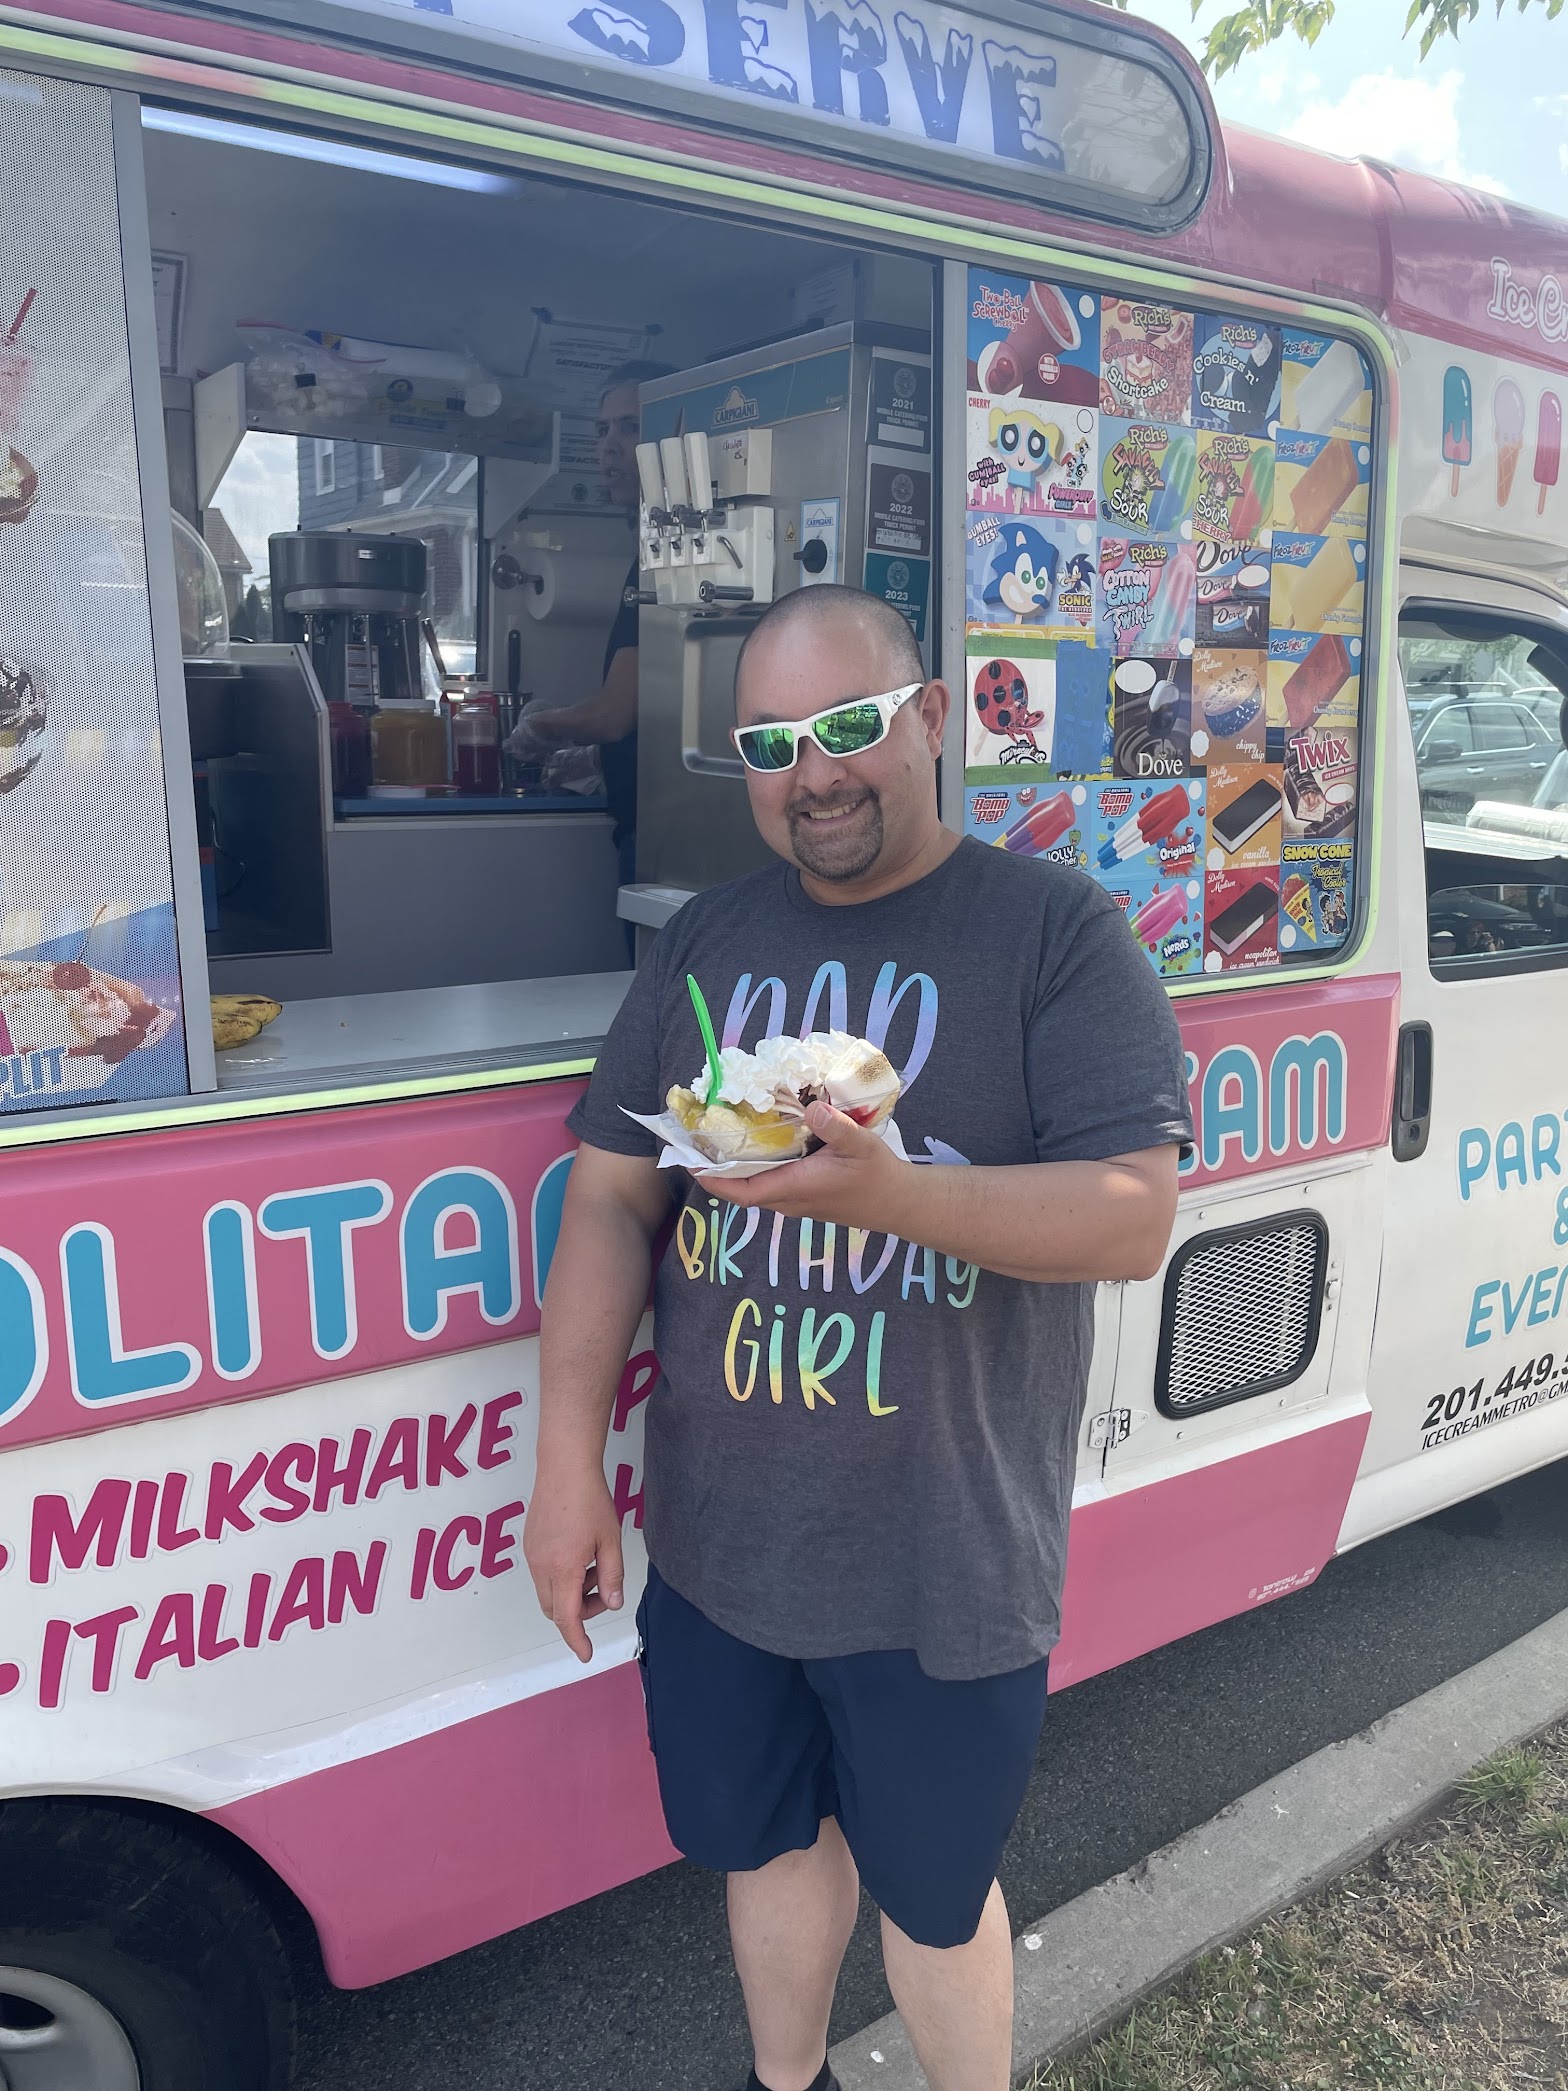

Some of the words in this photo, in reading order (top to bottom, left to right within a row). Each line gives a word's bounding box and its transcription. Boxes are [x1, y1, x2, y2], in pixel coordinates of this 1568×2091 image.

[1490, 260, 1533, 325] Ice
[1132, 307, 1172, 332] Rich's
[1220, 325, 1257, 347] Rich's
[1103, 338, 1175, 373] STRAWBERRY
[1193, 347, 1246, 374] Cookies
[1107, 366, 1169, 400] Shortcake
[892, 398, 914, 410] 2021
[968, 397, 991, 409] CHERRY
[1200, 391, 1246, 412] Cream
[715, 406, 756, 424] CARPIGIANI
[1129, 427, 1168, 448] Rich's
[1214, 439, 1249, 458] Rich's
[890, 503, 912, 515] 2022
[1111, 488, 1149, 522] SOUR
[1197, 494, 1229, 525] SOUR
[967, 518, 1001, 540] GUMBALL
[975, 529, 999, 547] EYES!
[1130, 545, 1168, 563] Rich's
[1196, 541, 1252, 573] Dove
[1102, 569, 1152, 592] COTTON
[1201, 579, 1230, 596] Dove
[885, 590, 908, 601] 2023
[1058, 594, 1092, 606] SONIC
[1106, 586, 1150, 606] CANDY
[1102, 605, 1154, 641] TWIRL
[1213, 608, 1244, 624] Dove
[1194, 650, 1210, 664] Dolly
[1196, 660, 1223, 673] Madison
[1236, 739, 1258, 755] chippy
[1137, 752, 1184, 776] Dove
[1251, 752, 1265, 763] chip
[1210, 766, 1227, 778] Dolly
[970, 798, 1011, 811] BOMB
[1097, 793, 1134, 805] BOMB
[971, 810, 1005, 824] POP
[1098, 804, 1130, 817] POP
[1159, 842, 1196, 860] Original
[1243, 846, 1269, 859] vanilla
[1282, 845, 1317, 861] SNOW
[1319, 844, 1353, 859] CONE
[1207, 871, 1225, 883] Dolly
[1210, 880, 1236, 893] Madison
[1245, 947, 1277, 962] neapolitan
[1180, 1030, 1347, 1177] AM
[0, 1165, 565, 1425] LITA
[29, 1391, 523, 1584] MILKSHAKE
[39, 1540, 387, 1708] ITALIAN
[410, 1500, 524, 1599] ICE
